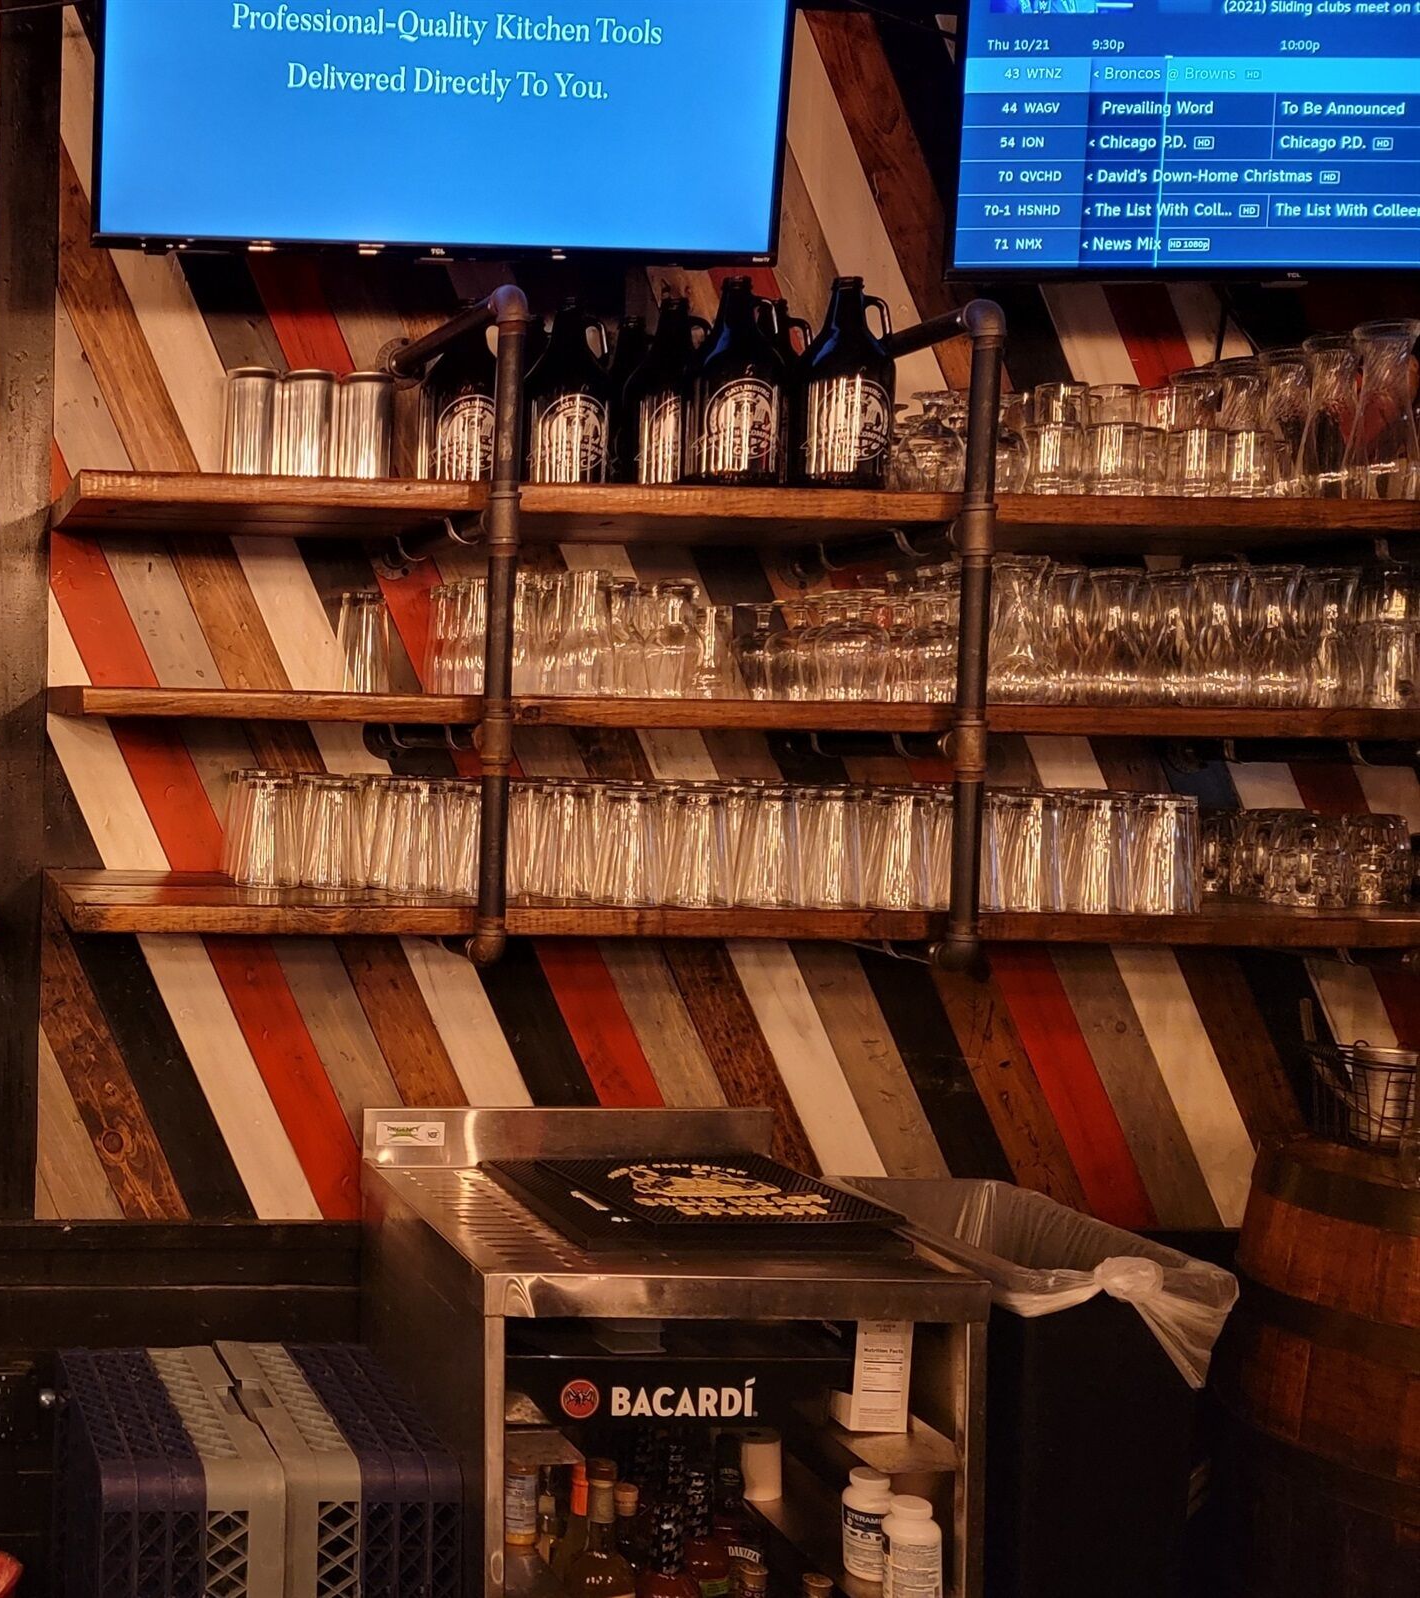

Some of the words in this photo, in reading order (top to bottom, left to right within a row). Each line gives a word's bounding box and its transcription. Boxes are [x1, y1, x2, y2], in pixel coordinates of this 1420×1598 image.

[1224, 0, 1266, 14] (2021)
[1271, 0, 1313, 16] Sliding
[1317, 0, 1351, 13] clubs
[1356, 1, 1389, 13] meet
[1394, 4, 1411, 13] on
[232, 3, 488, 45] Professional-Quality
[495, 14, 590, 42] Kitchen
[595, 18, 662, 45] Tools
[987, 39, 1009, 50] Thu
[1014, 39, 1050, 51] 10/21
[1092, 39, 1125, 53] 9:30p
[1280, 40, 1320, 53] 10:00p
[1004, 68, 1020, 79] 43
[1026, 68, 1062, 79] WTNZ
[1104, 66, 1161, 80] Broncos
[1185, 67, 1236, 81] Browns
[287, 62, 406, 93] Delivered
[414, 67, 512, 103] Directly
[516, 71, 549, 97] To
[554, 72, 609, 99] You.
[1001, 102, 1017, 113] 44
[1024, 102, 1060, 113] WAGV
[1102, 101, 1171, 117] Prevailing
[1177, 101, 1214, 114] Word
[1282, 101, 1299, 115] To
[1304, 102, 1322, 114] Be
[1327, 102, 1406, 115] Announced
[1000, 137, 1015, 148] 54
[1022, 137, 1044, 148] ION
[1100, 135, 1157, 151] Chicago
[1162, 135, 1187, 148] P.D.
[1280, 136, 1336, 151] Chicago
[1341, 136, 1366, 149] P.D.
[998, 170, 1013, 182] 70
[1020, 170, 1062, 182] QVCHD
[1098, 169, 1148, 183] David's
[1153, 169, 1238, 183] Down-Home
[1244, 169, 1313, 182] Christmas
[984, 205, 1011, 216] 70-1
[1018, 204, 1060, 216] HSNHD
[1095, 203, 1121, 216] The
[1126, 203, 1152, 216] List
[1157, 203, 1188, 216] With
[1194, 203, 1232, 217] Coll...
[1276, 203, 1301, 216] The
[1306, 203, 1331, 216] List
[1336, 203, 1368, 217] With
[994, 238, 1008, 250] 71
[1016, 238, 1043, 250] NMX
[1093, 237, 1132, 250] News
[1137, 237, 1161, 250] Mix
[725, 384, 771, 398] GATLINBURG
[611, 1376, 756, 1417] BACARDÍ
[846, 1510, 879, 1524] STERAM
